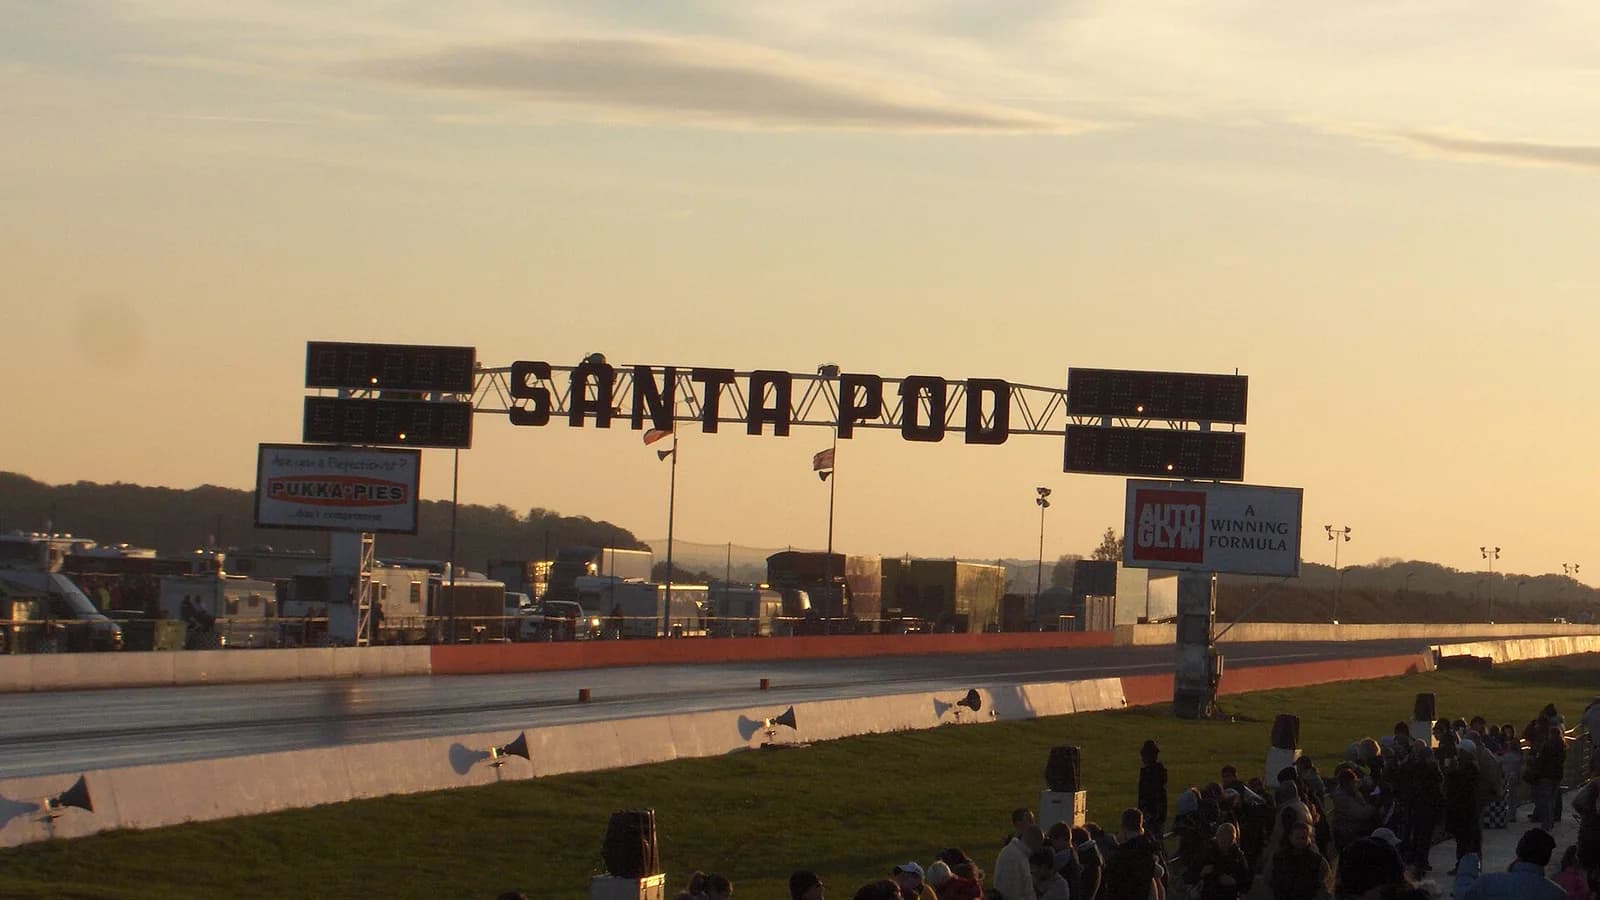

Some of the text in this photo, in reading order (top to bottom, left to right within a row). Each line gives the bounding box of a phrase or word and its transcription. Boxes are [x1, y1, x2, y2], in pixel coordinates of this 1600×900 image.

[509, 361, 1010, 445] SANTA POD
[1139, 503, 1201, 526] AUTO
[1245, 504, 1255, 517] A
[1137, 523, 1200, 549] GLYM
[1211, 519, 1289, 535] WINNING
[1209, 535, 1287, 551] FORMULA
